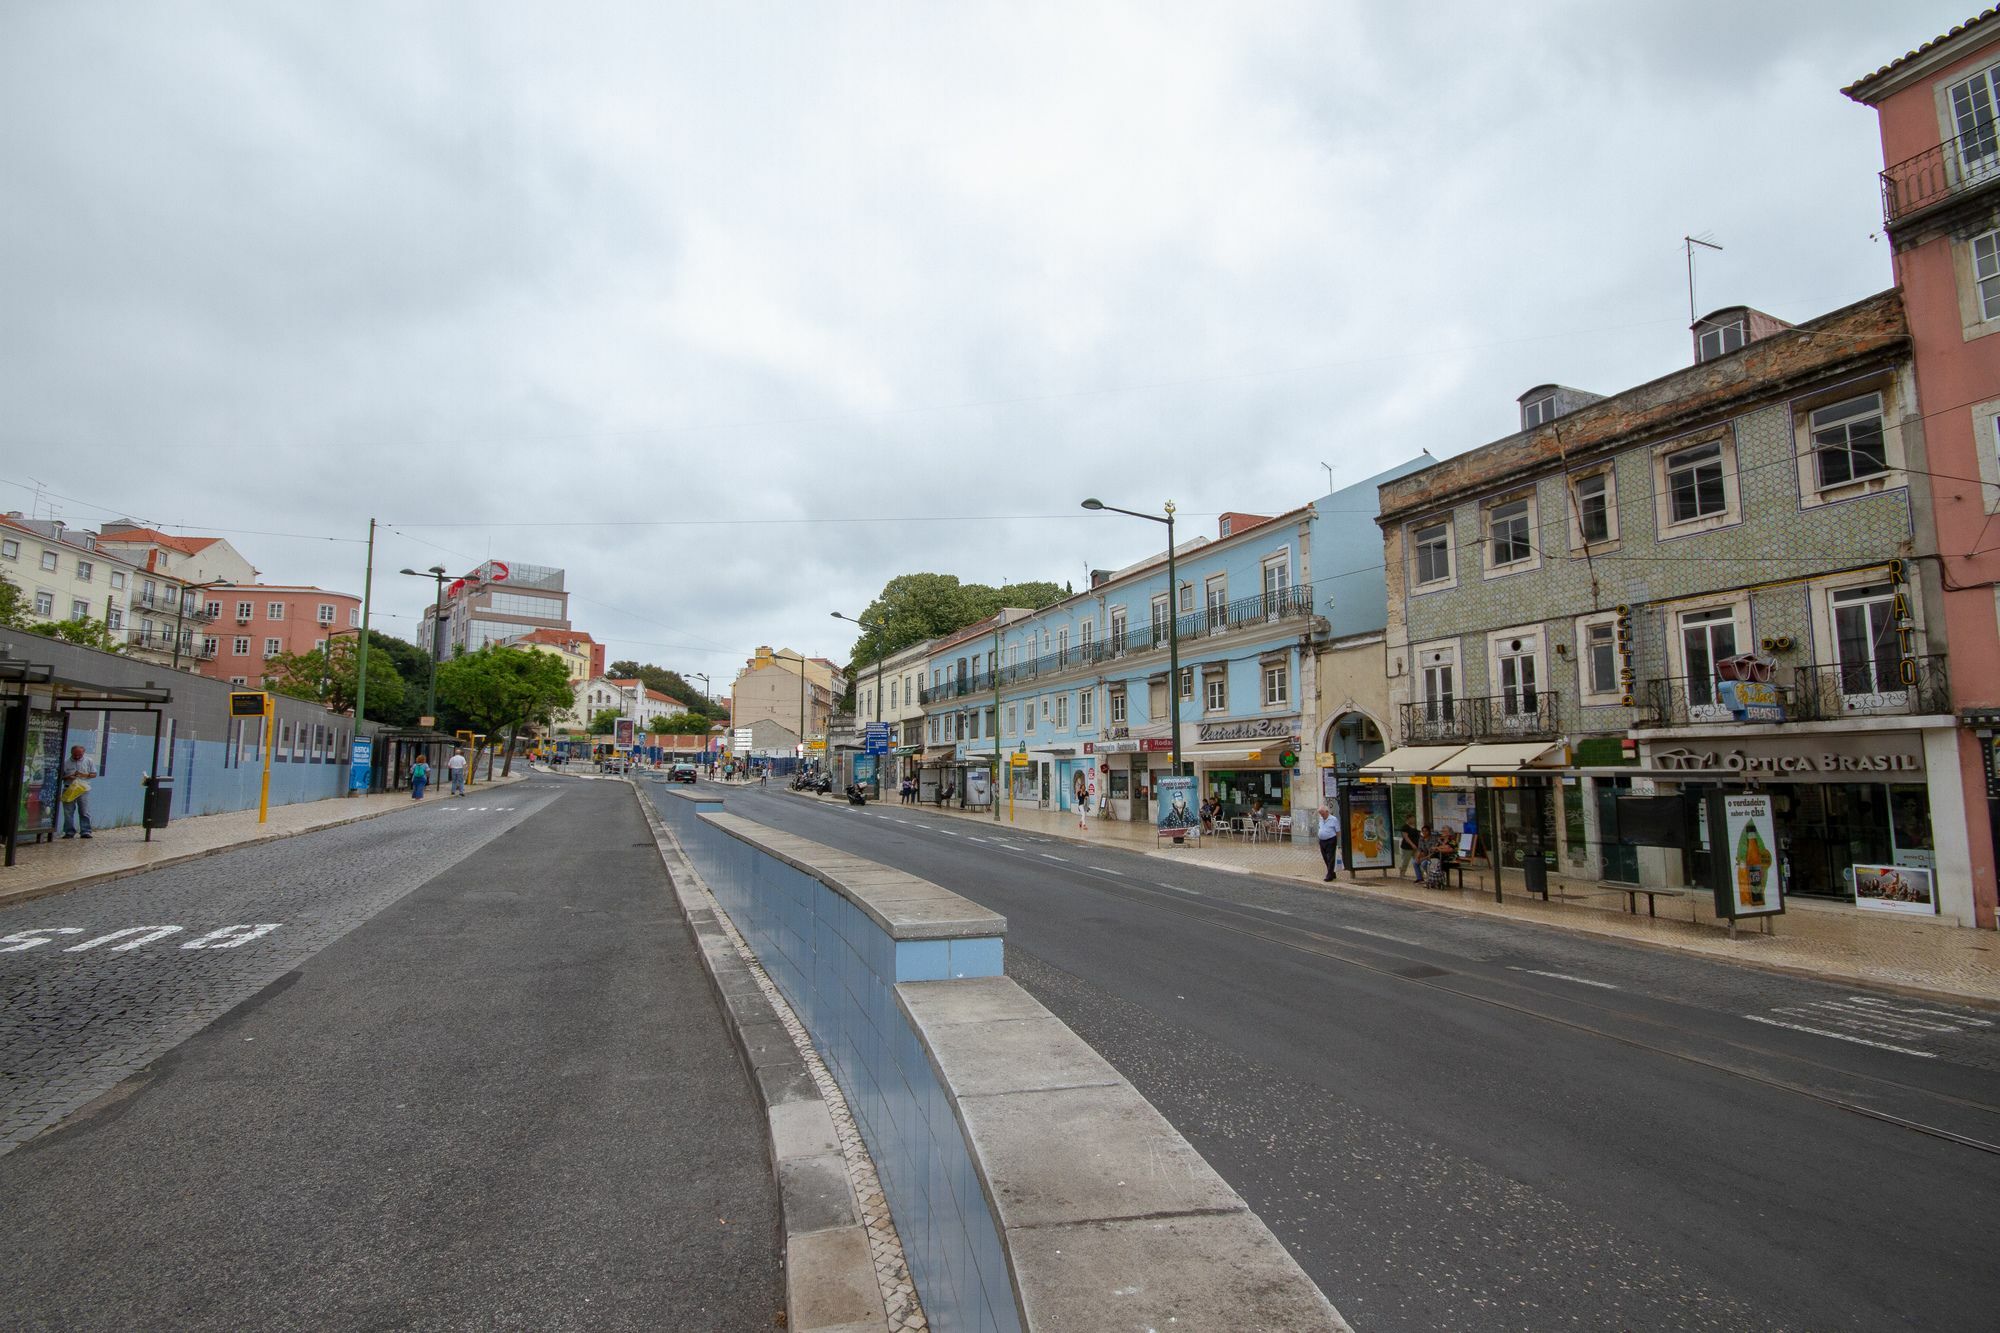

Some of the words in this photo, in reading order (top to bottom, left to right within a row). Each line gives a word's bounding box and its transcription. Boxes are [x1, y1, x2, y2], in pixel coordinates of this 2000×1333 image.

[1888, 559, 1916, 686] RATO
[1762, 637, 1790, 651] DO
[1616, 603, 1635, 707] OCULISTA
[1200, 723, 1241, 741] Central
[1256, 719, 1288, 736] Rato
[1821, 752, 1918, 771] BRASIL
[1733, 799, 1765, 807] verdadeiro
[1751, 807, 1765, 816] chá
